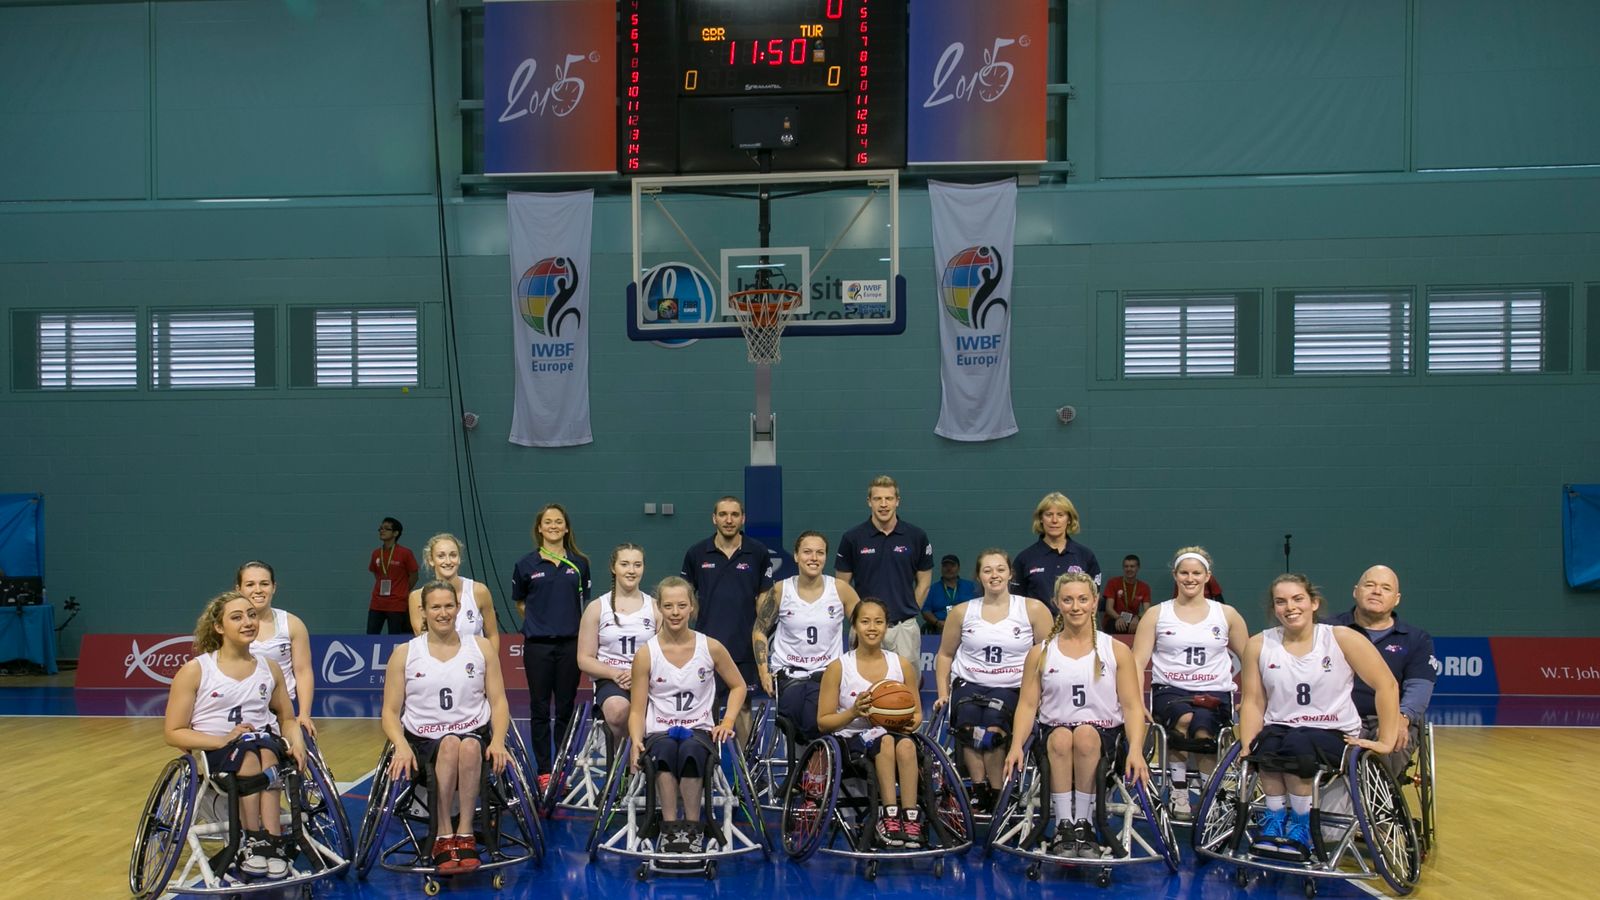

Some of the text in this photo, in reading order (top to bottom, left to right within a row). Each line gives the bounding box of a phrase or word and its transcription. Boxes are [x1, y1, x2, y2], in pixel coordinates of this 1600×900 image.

[859, 7, 868, 18] 5
[631, 14, 639, 25] 5
[800, 24, 823, 39] TUR
[859, 21, 868, 33] 6
[631, 28, 639, 40] 6
[702, 27, 725, 41] GBR
[860, 36, 868, 47] 7
[631, 43, 639, 53] 7
[729, 38, 807, 65] 11:50
[631, 57, 639, 68] 8
[859, 51, 868, 63] 8
[828, 66, 841, 87] 0
[859, 65, 868, 77] 9
[631, 72, 639, 83] 9
[685, 70, 698, 90] 0
[628, 86, 639, 97] 10
[628, 101, 639, 111] 11
[857, 95, 868, 105] 11
[628, 115, 639, 126] 12
[857, 109, 868, 120] 12
[857, 123, 868, 135] 13
[628, 144, 639, 155] 14
[628, 158, 639, 169] 15
[857, 152, 868, 164] 15
[956, 335, 1001, 351] IWBF
[531, 343, 575, 358] IWBF
[532, 360, 574, 374] Europe
[806, 626, 818, 645] 9
[618, 636, 636, 655] 11
[982, 645, 1003, 664] 13
[1183, 646, 1206, 667] 15
[1444, 656, 1483, 677] RIO
[439, 687, 453, 710] 6
[1072, 684, 1086, 707] 5
[1296, 683, 1311, 705] 8
[673, 691, 695, 711] 12
[228, 705, 243, 726] 4
[417, 724, 447, 734] GREAT
